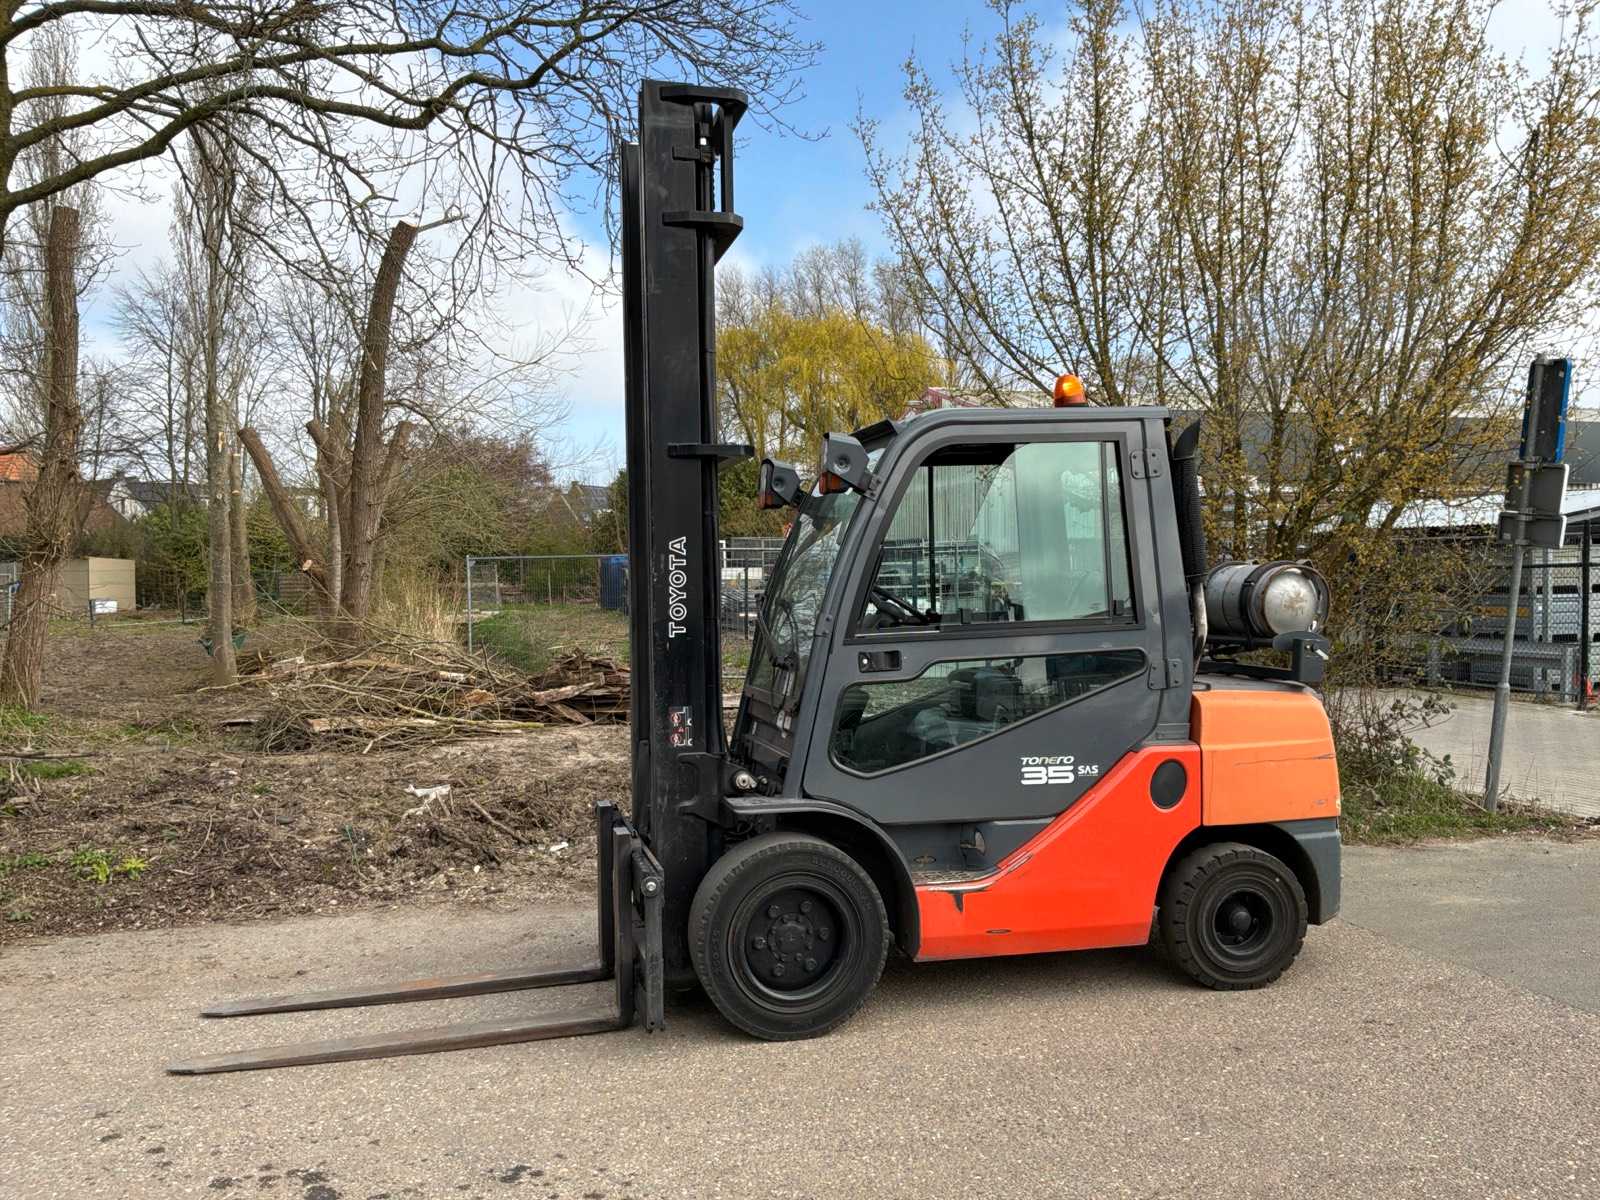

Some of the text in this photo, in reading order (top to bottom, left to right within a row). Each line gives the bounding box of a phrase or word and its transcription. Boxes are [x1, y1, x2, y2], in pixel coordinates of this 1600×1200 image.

[669, 536, 687, 638] TOYOTA
[1020, 765, 1099, 785] 35 SAS
